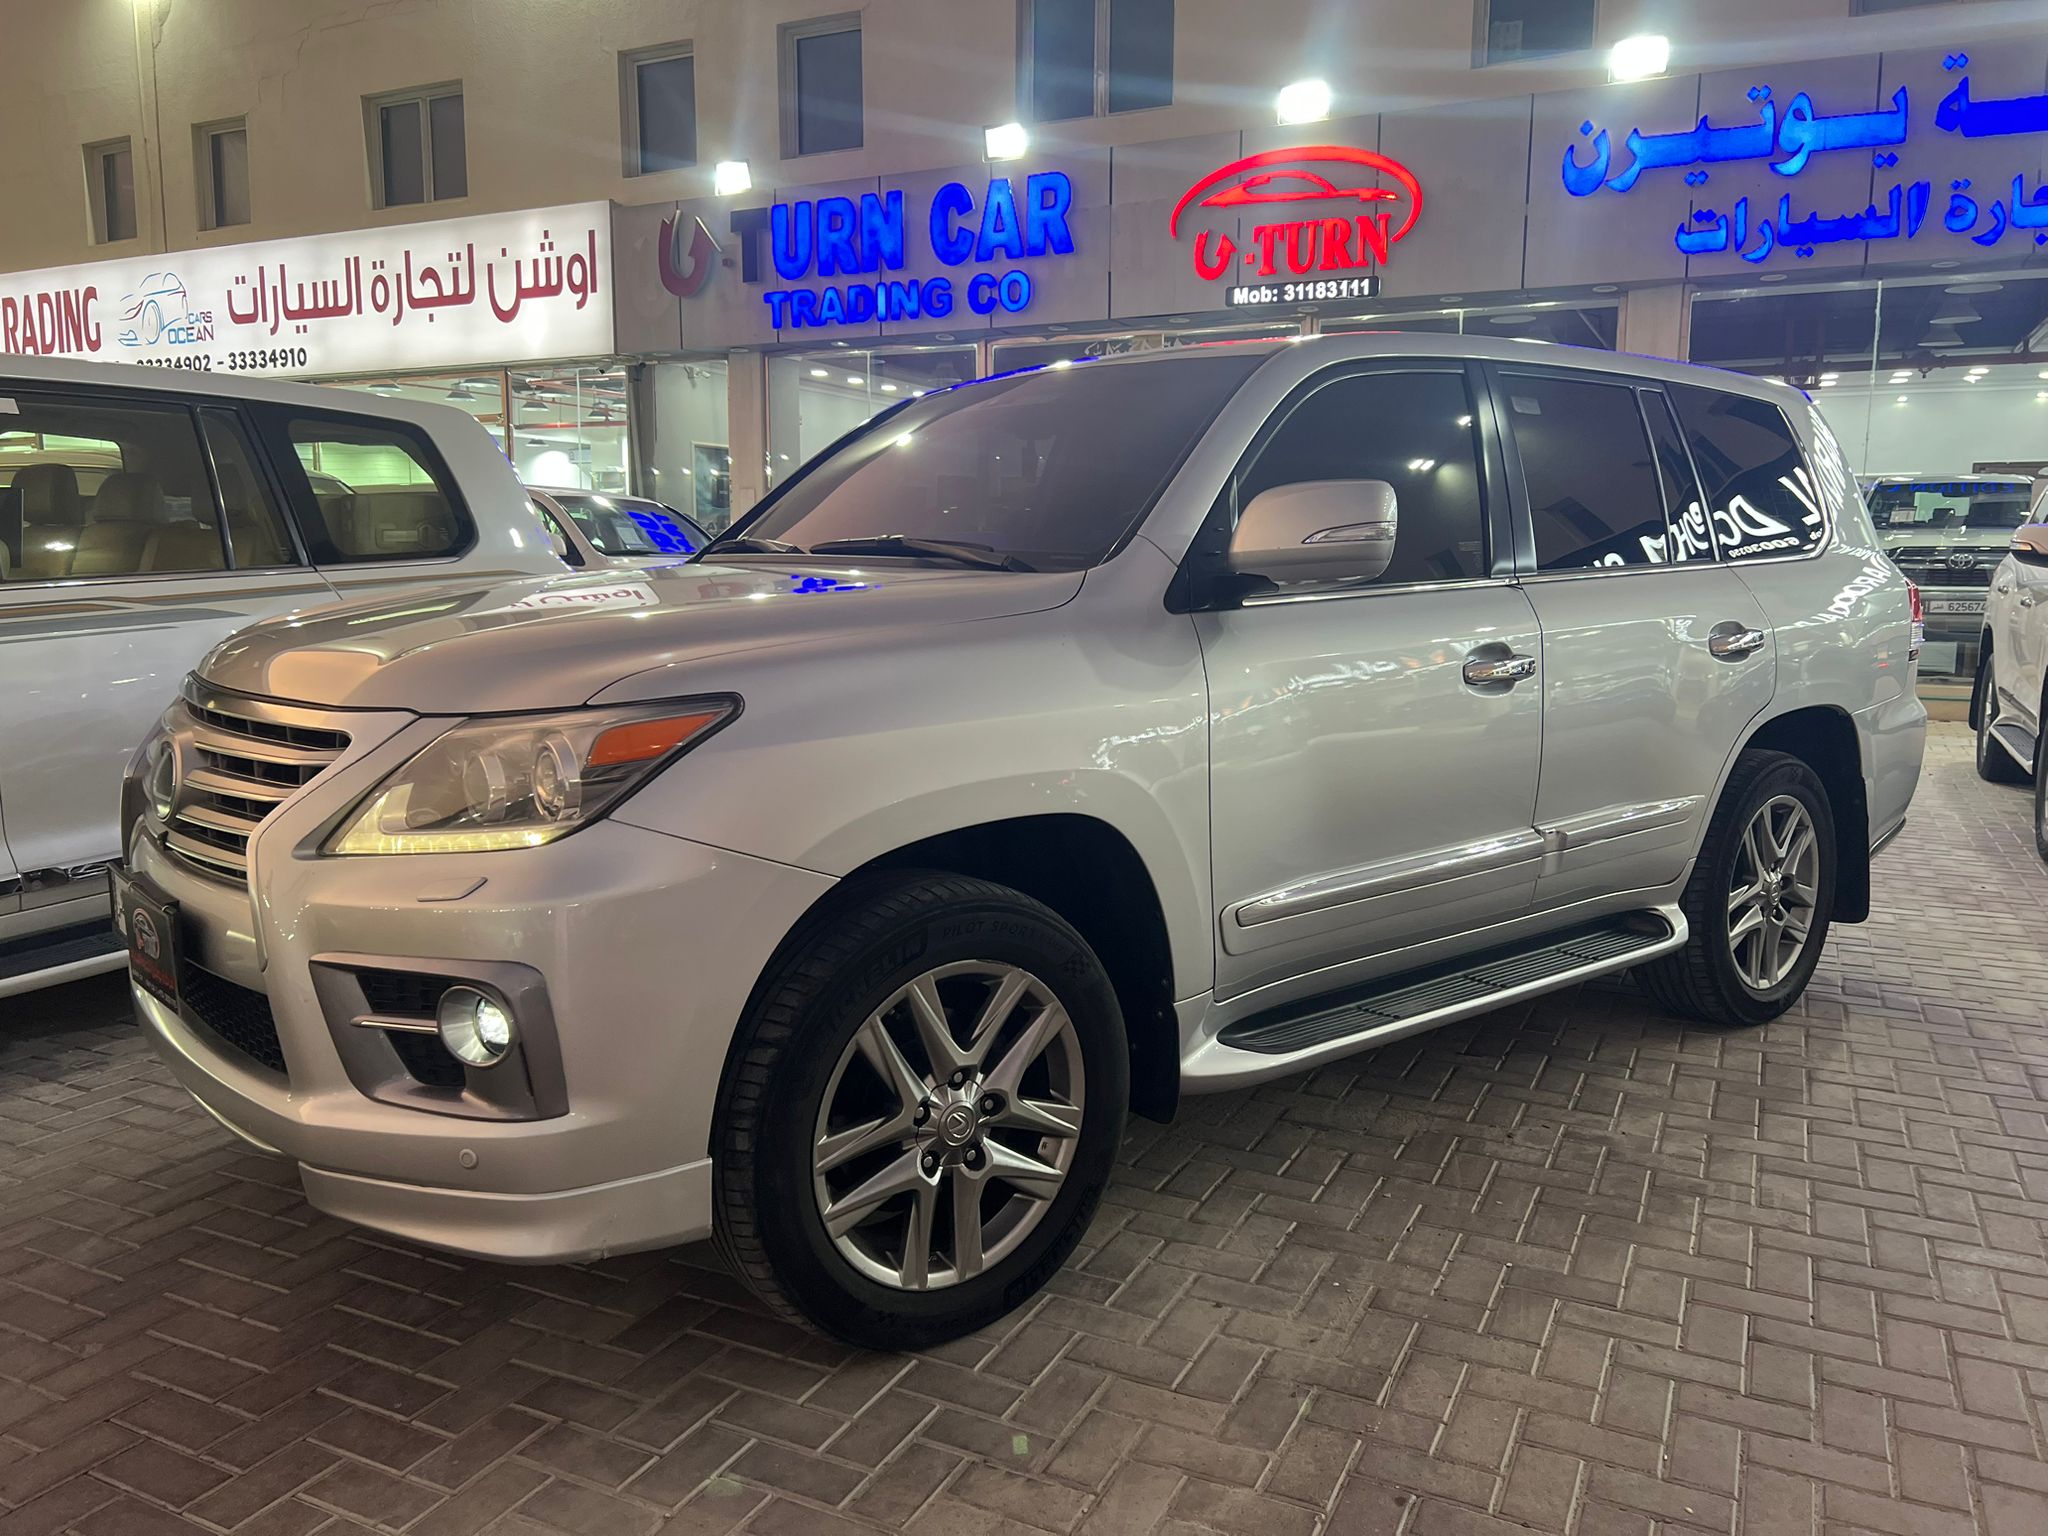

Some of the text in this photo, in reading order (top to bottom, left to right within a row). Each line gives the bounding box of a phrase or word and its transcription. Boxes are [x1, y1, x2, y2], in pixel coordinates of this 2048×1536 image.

[929, 171, 1075, 267] CAR
[1674, 180, 1931, 265] السيارات
[226, 229, 598, 336] اوشن لتجارة السيارات
[763, 269, 1032, 330] TRADING CO
[1283, 278, 1370, 302] 31183111
[167, 325, 215, 345] OCEAN
[187, 311, 214, 324] CARS
[228, 347, 308, 371] 33334910
